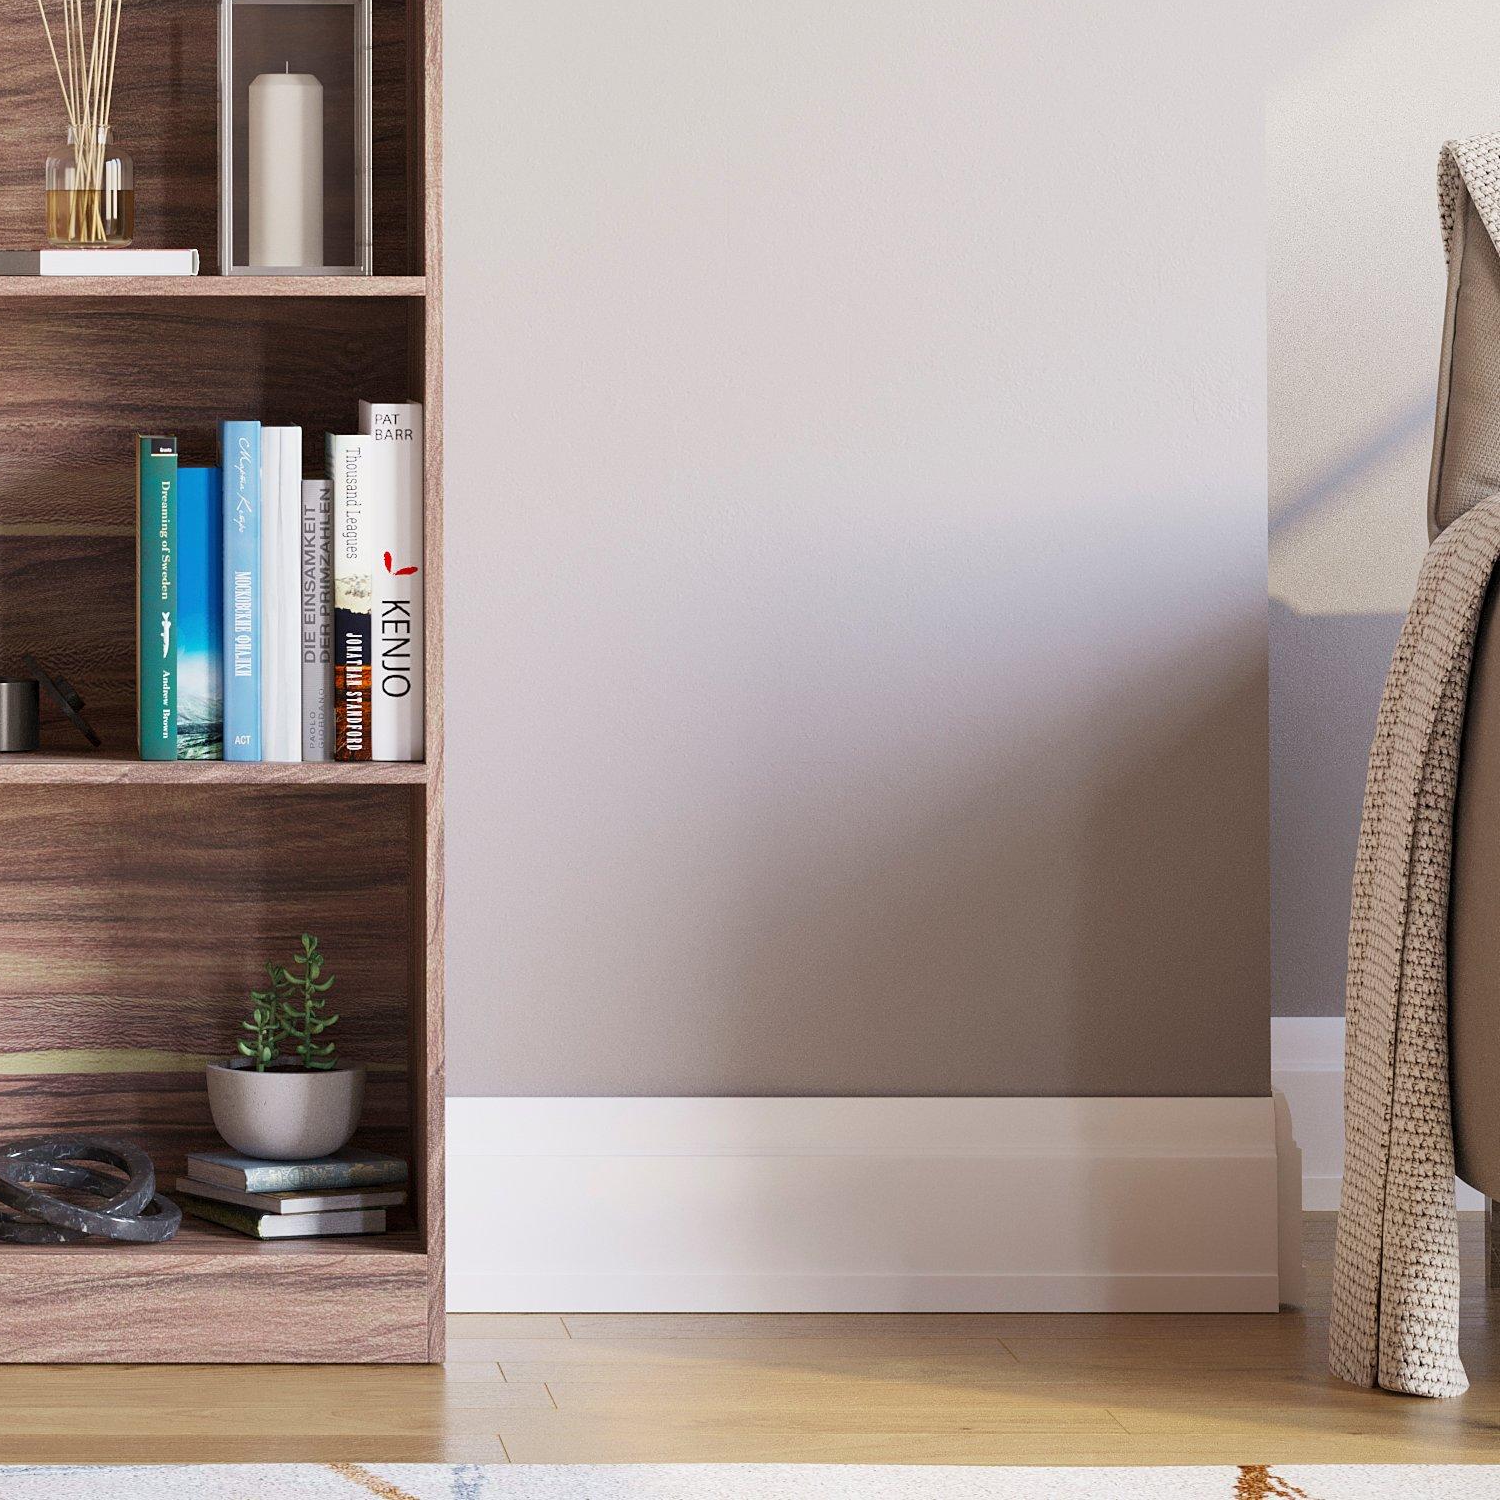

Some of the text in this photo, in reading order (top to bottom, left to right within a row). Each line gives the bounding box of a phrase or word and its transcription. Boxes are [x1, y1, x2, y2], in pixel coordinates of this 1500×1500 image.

[374, 413, 400, 426] PAT
[374, 428, 413, 441] BARR
[160, 481, 171, 600] Dreaming of Sweden
[342, 447, 362, 560] Thousand Leagues
[304, 505, 316, 663] DIE EINSAMKEIT
[319, 488, 331, 663] DER PRIMZAHLEN
[162, 670, 171, 739] Andrew Brown
[346, 632, 362, 751] JONATHAN STANDFORD
[381, 599, 411, 699] KENJO
